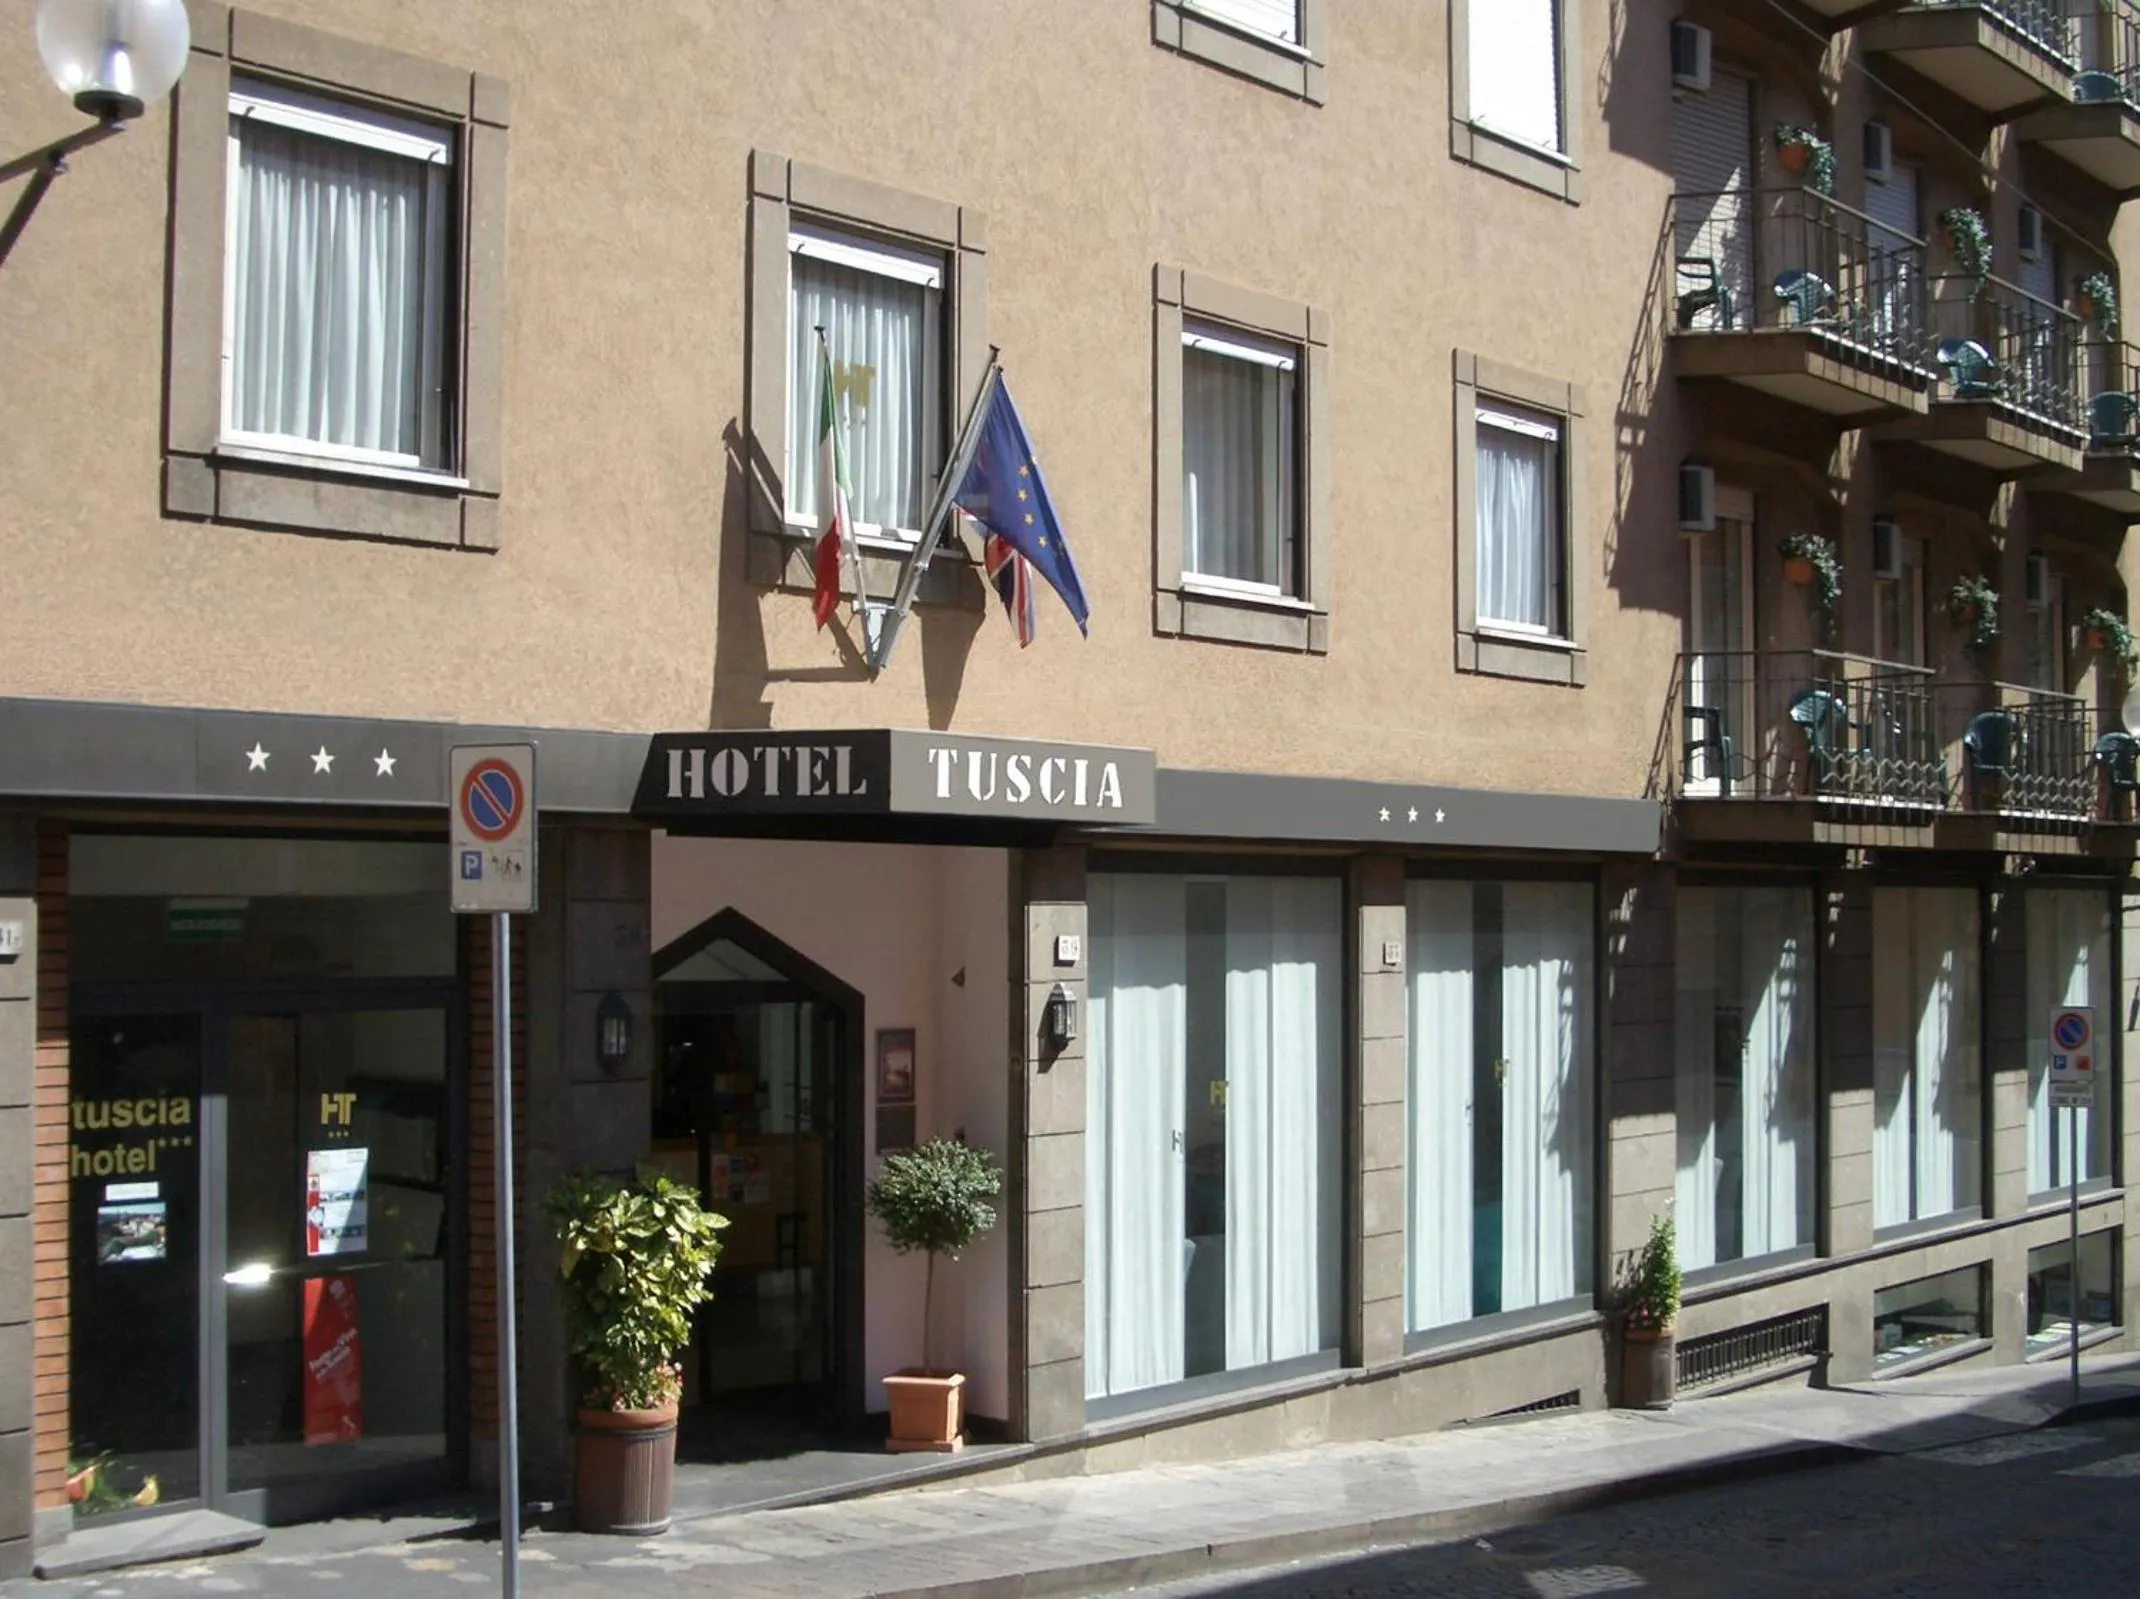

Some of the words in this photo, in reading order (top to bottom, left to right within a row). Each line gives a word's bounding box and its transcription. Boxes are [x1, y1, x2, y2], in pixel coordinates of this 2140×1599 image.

[665, 746, 867, 799] HOTEL
[928, 748, 1124, 808] TUSCIA
[71, 1092, 191, 1130] tuscia
[320, 1093, 357, 1125] HT
